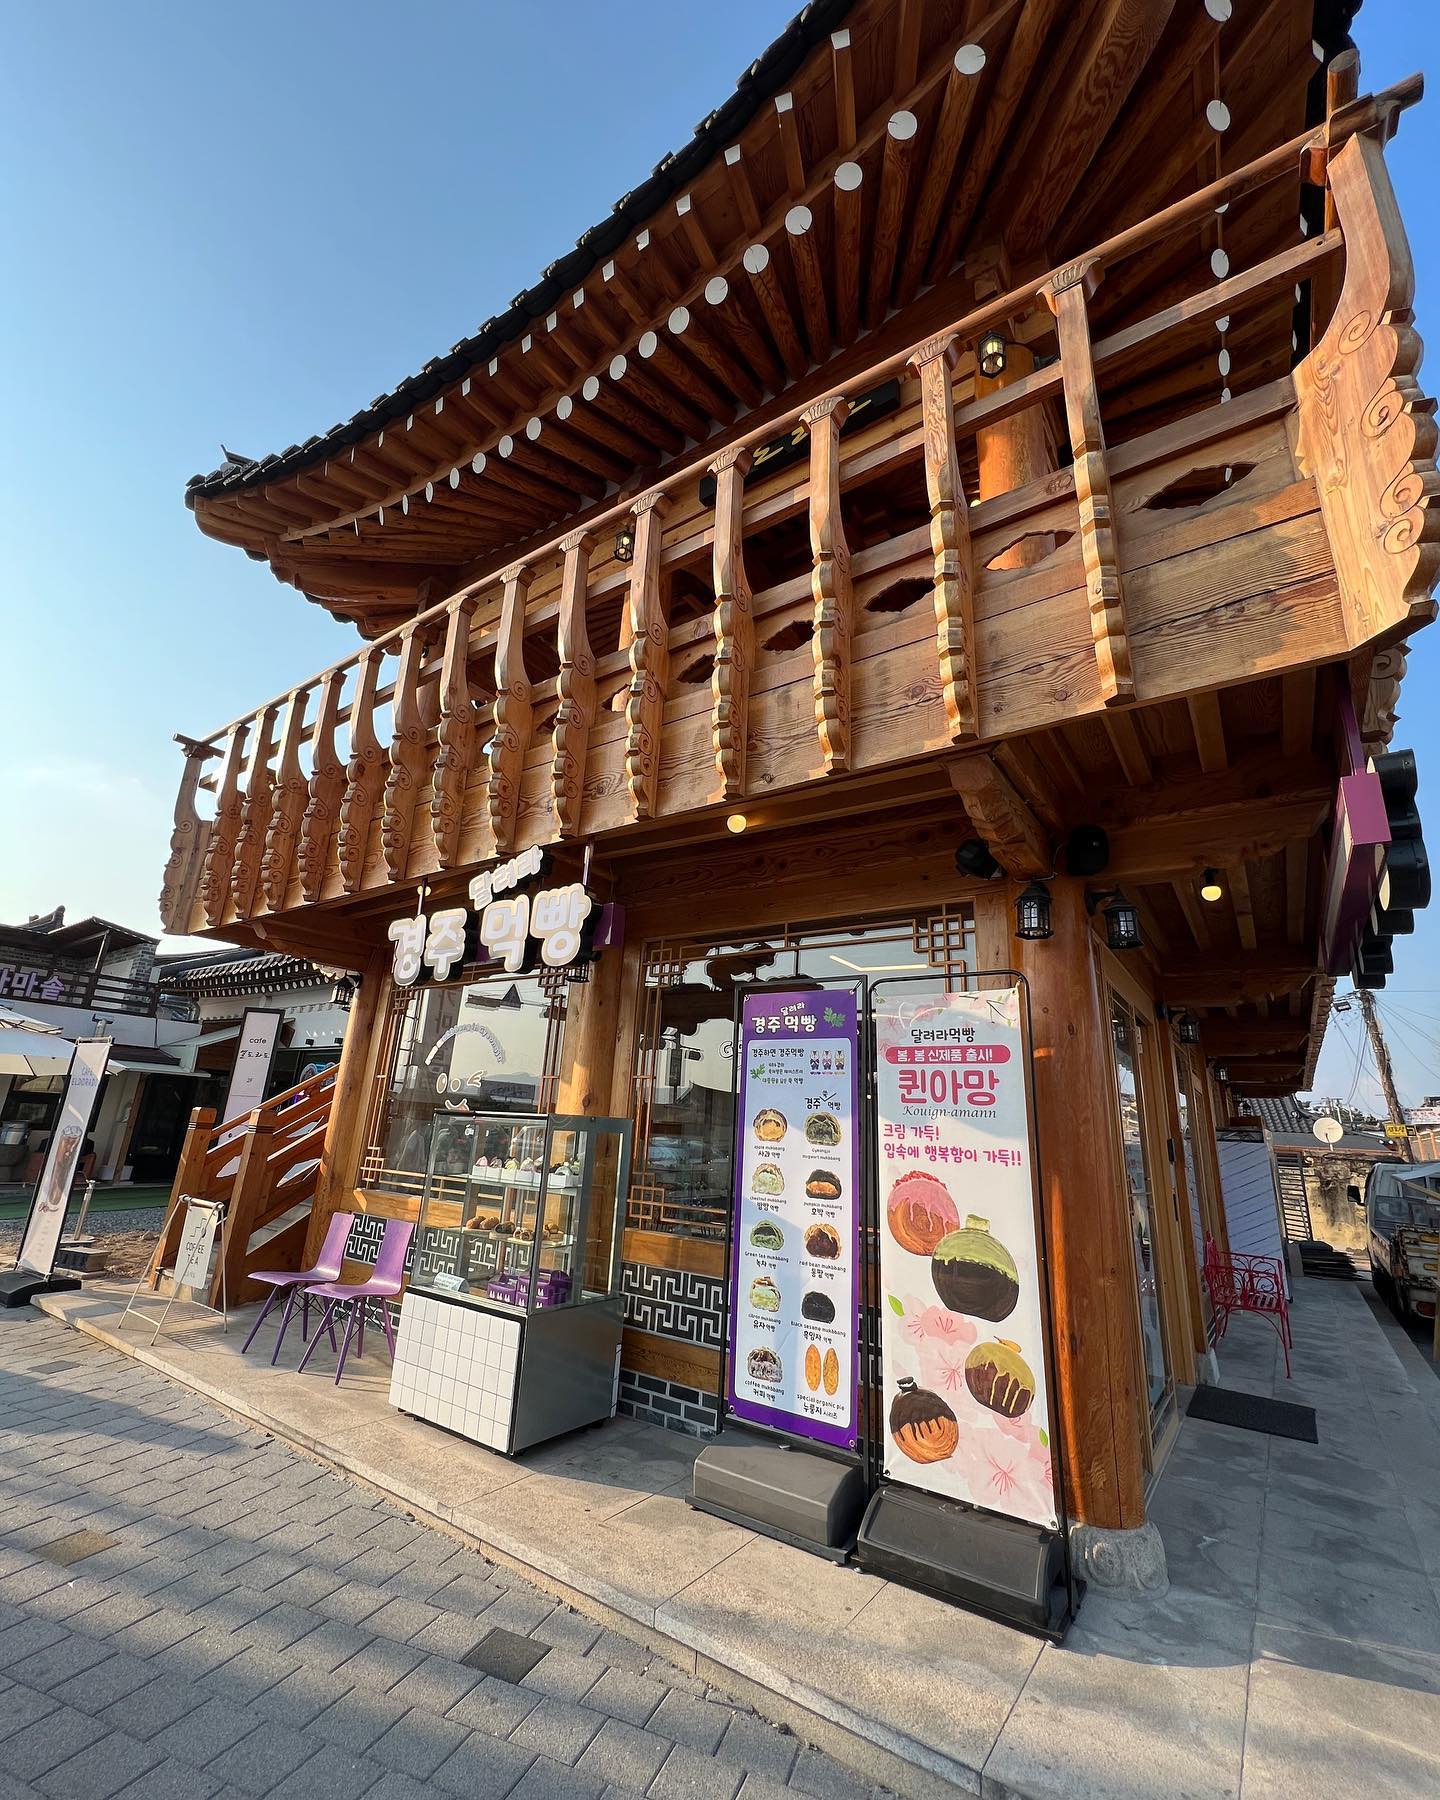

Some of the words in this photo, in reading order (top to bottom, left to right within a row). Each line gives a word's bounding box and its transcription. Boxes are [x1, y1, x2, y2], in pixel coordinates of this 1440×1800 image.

[469, 844, 543, 910] 달려라
[780, 1002, 806, 1015] 달려라
[911, 1026, 976, 1044] 달려라먹빵
[914, 1049, 925, 1062] 봄
[927, 1048, 962, 1062] 신제품
[965, 1048, 993, 1062] 출시!
[898, 1069, 1000, 1107] 퀸아망
[805, 1097, 821, 1110] 경주
[902, 1105, 997, 1120] Kouign-amann
[883, 1123, 906, 1140] 크림
[910, 1125, 940, 1142] 가득!
[883, 1143, 920, 1159] 입속에
[924, 1145, 978, 1163] 행복함이
[984, 1148, 1022, 1167] 가득!!
[753, 1319, 765, 1329] 유자
[803, 1402, 822, 1414] 누룽지
